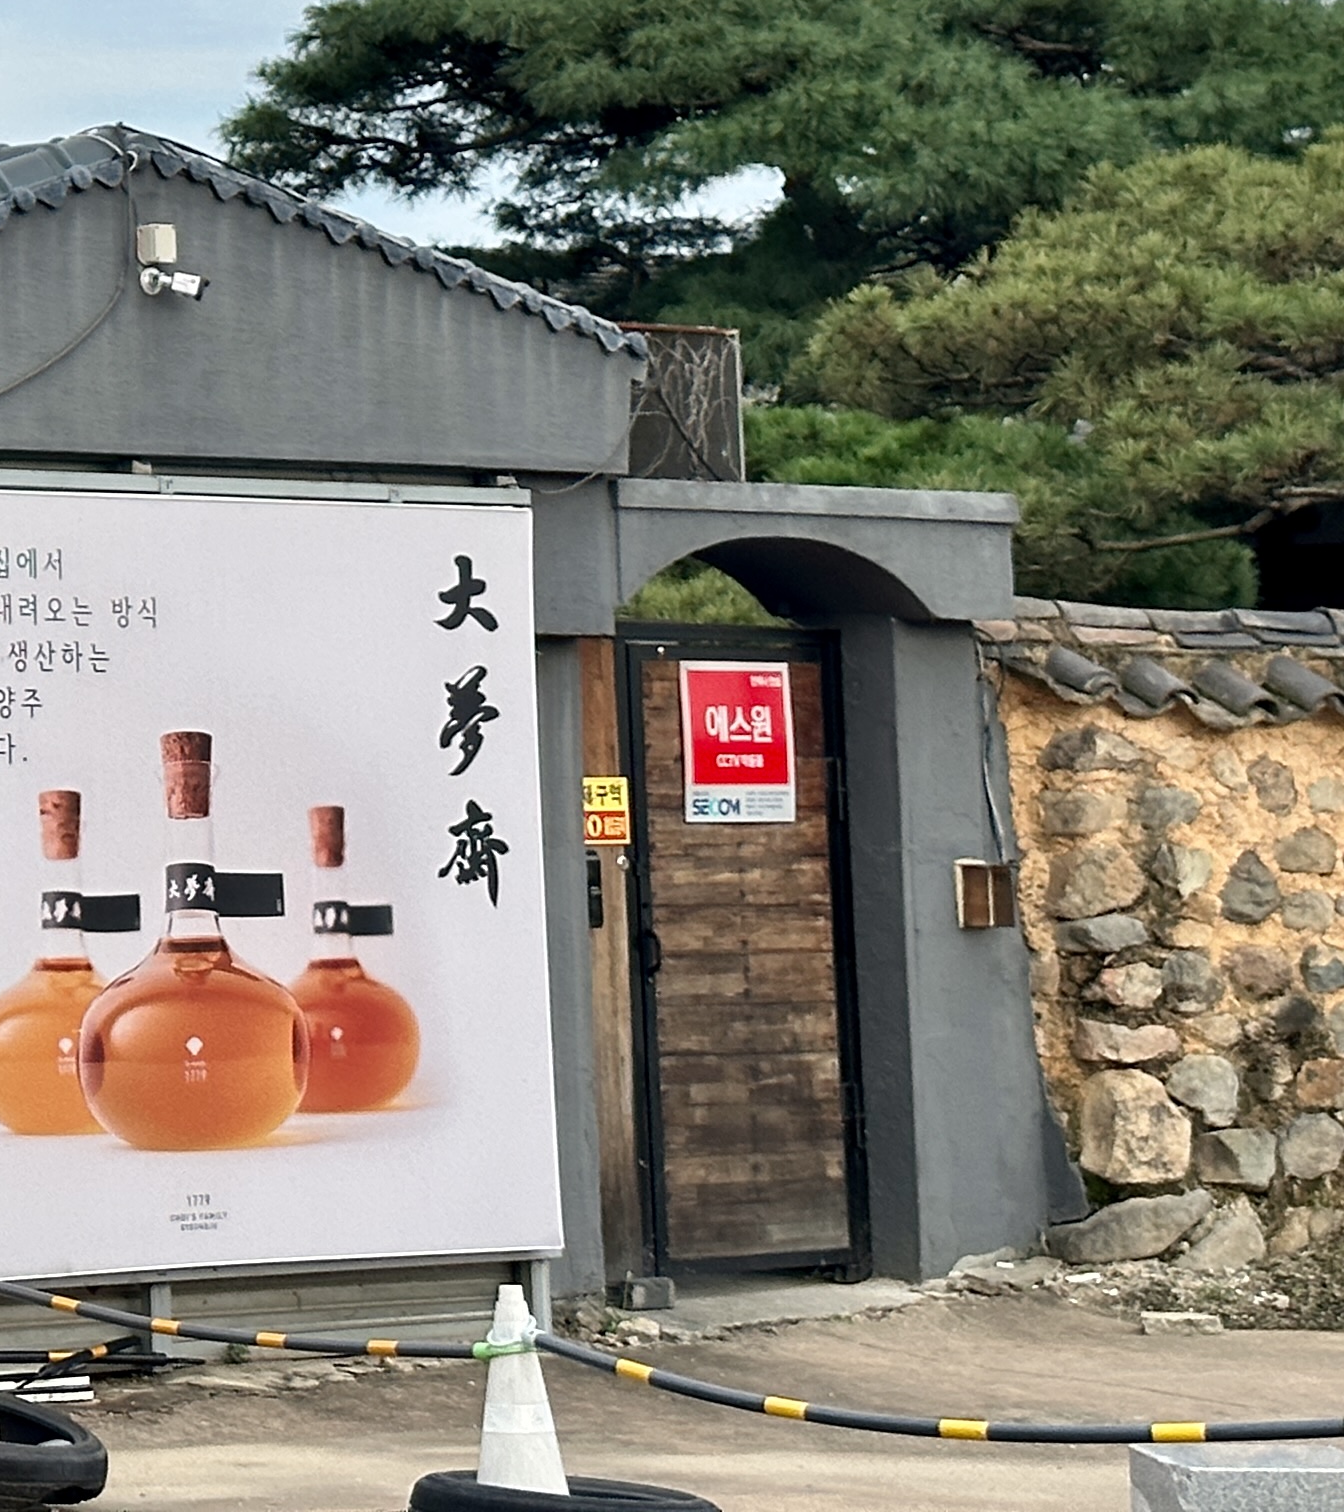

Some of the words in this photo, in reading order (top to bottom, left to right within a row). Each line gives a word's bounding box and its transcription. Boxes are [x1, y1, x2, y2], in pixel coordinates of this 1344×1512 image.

[111, 596, 158, 629] 방식
[8, 640, 111, 673] 생산하는
[704, 705, 774, 744] 에스원
[692, 797, 741, 816] SECOM
